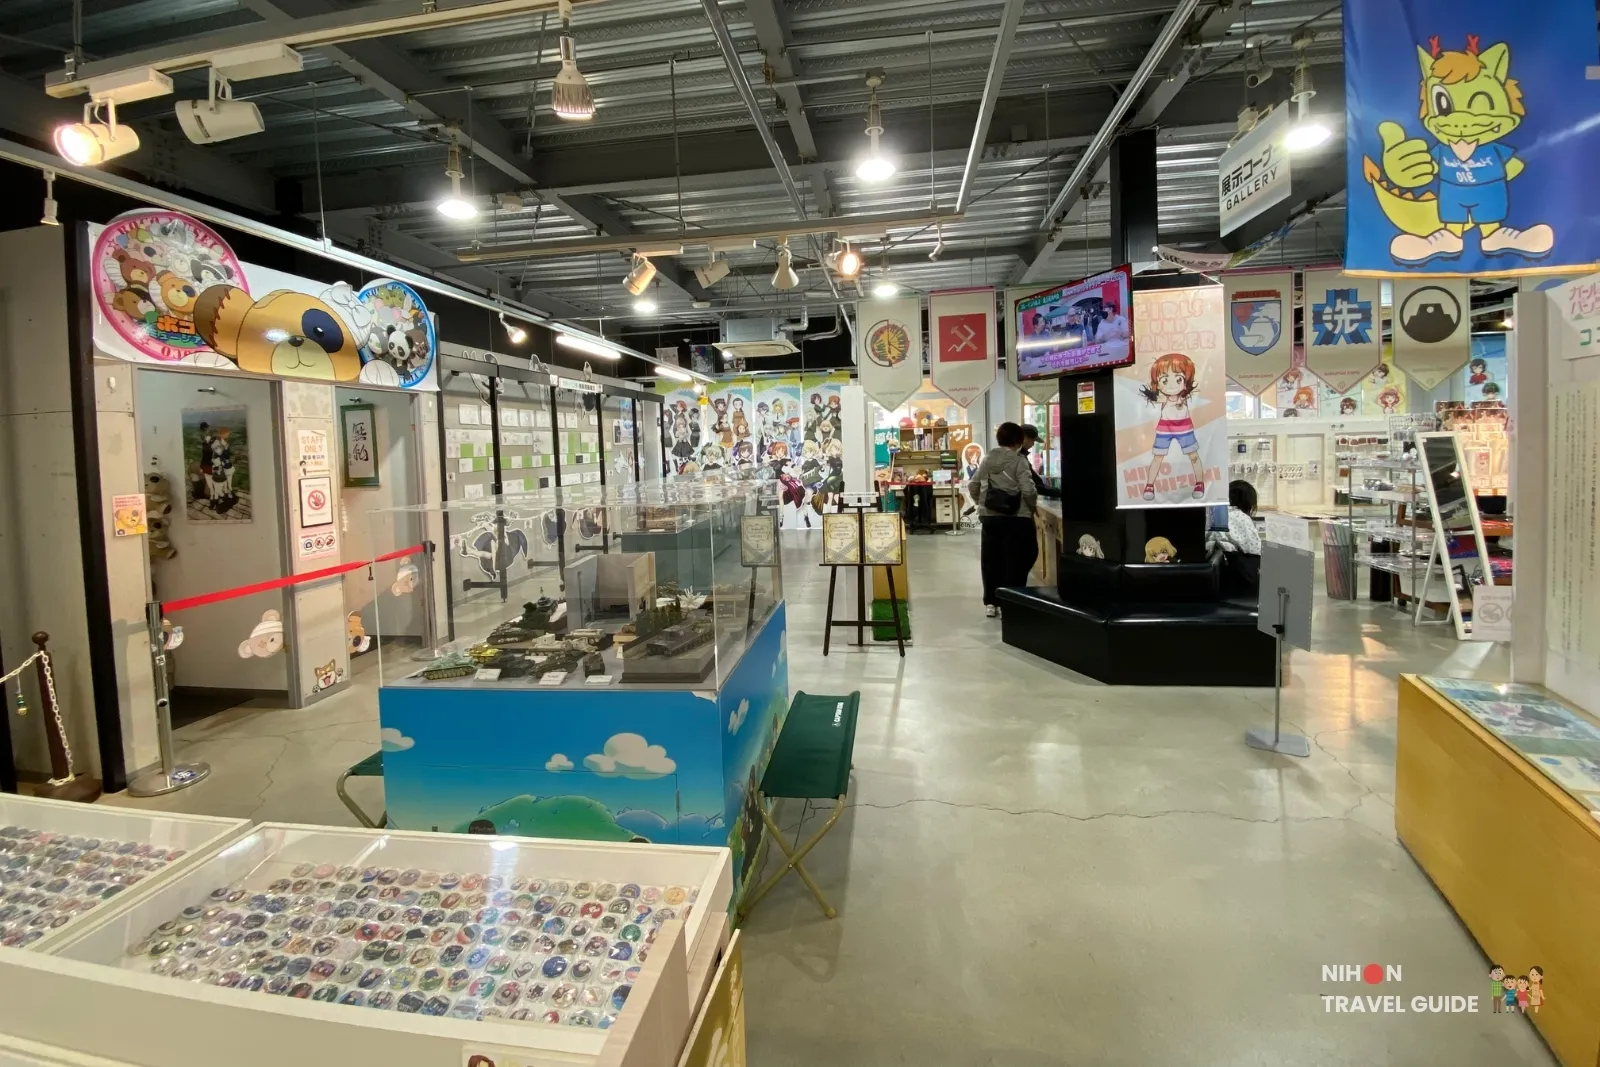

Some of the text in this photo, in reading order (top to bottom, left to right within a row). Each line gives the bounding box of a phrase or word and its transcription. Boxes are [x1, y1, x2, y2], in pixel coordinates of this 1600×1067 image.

[1226, 166, 1278, 211] GALLERY
[1135, 299, 1204, 321] GIRLS
[1321, 299, 1363, 335] 洗
[1149, 319, 1188, 335] UND
[1136, 330, 1216, 353] ANZER
[300, 436, 325, 445] STAFF
[304, 444, 324, 453] ONLY
[1126, 466, 1222, 499] NIHIZMI
